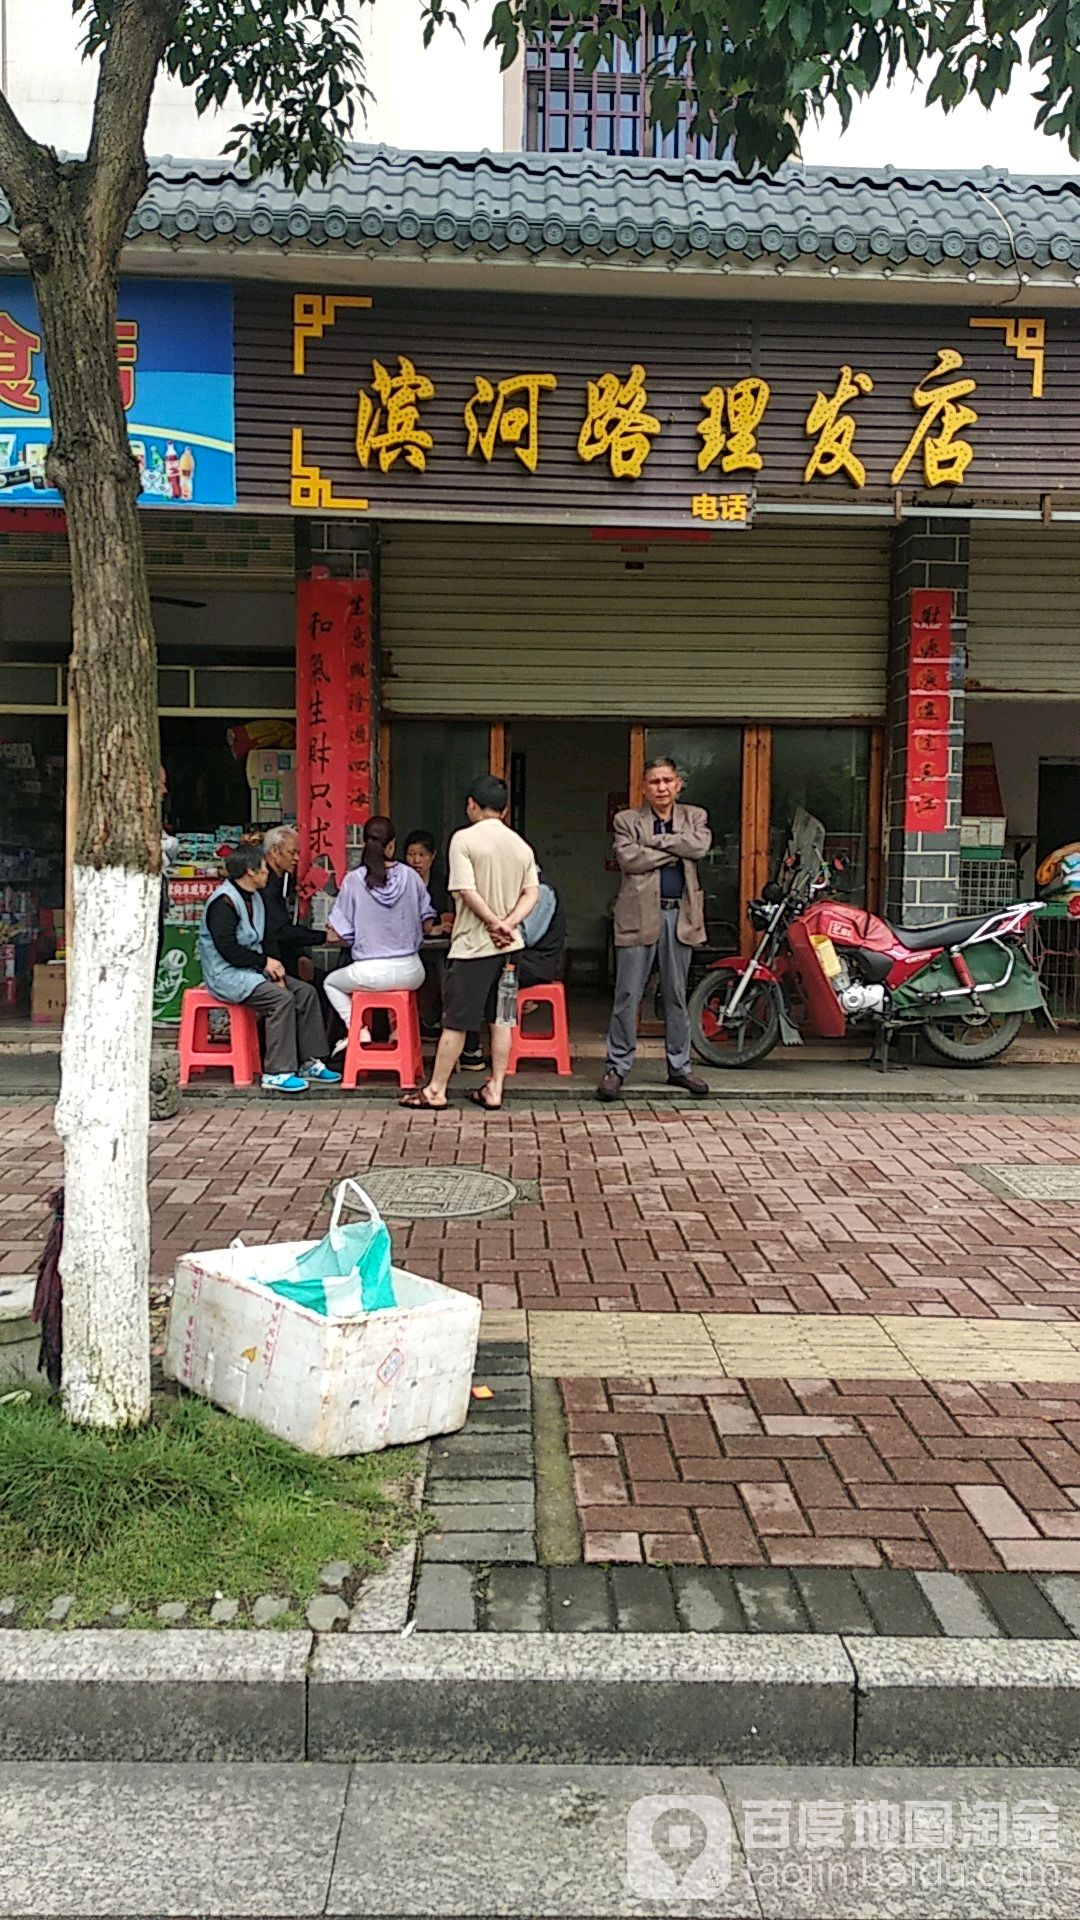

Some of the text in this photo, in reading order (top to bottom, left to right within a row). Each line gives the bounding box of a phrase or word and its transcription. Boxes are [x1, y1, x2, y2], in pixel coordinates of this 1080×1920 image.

[355, 348, 979, 487] 滨河路理发店
[691, 493, 748, 521] 电话
